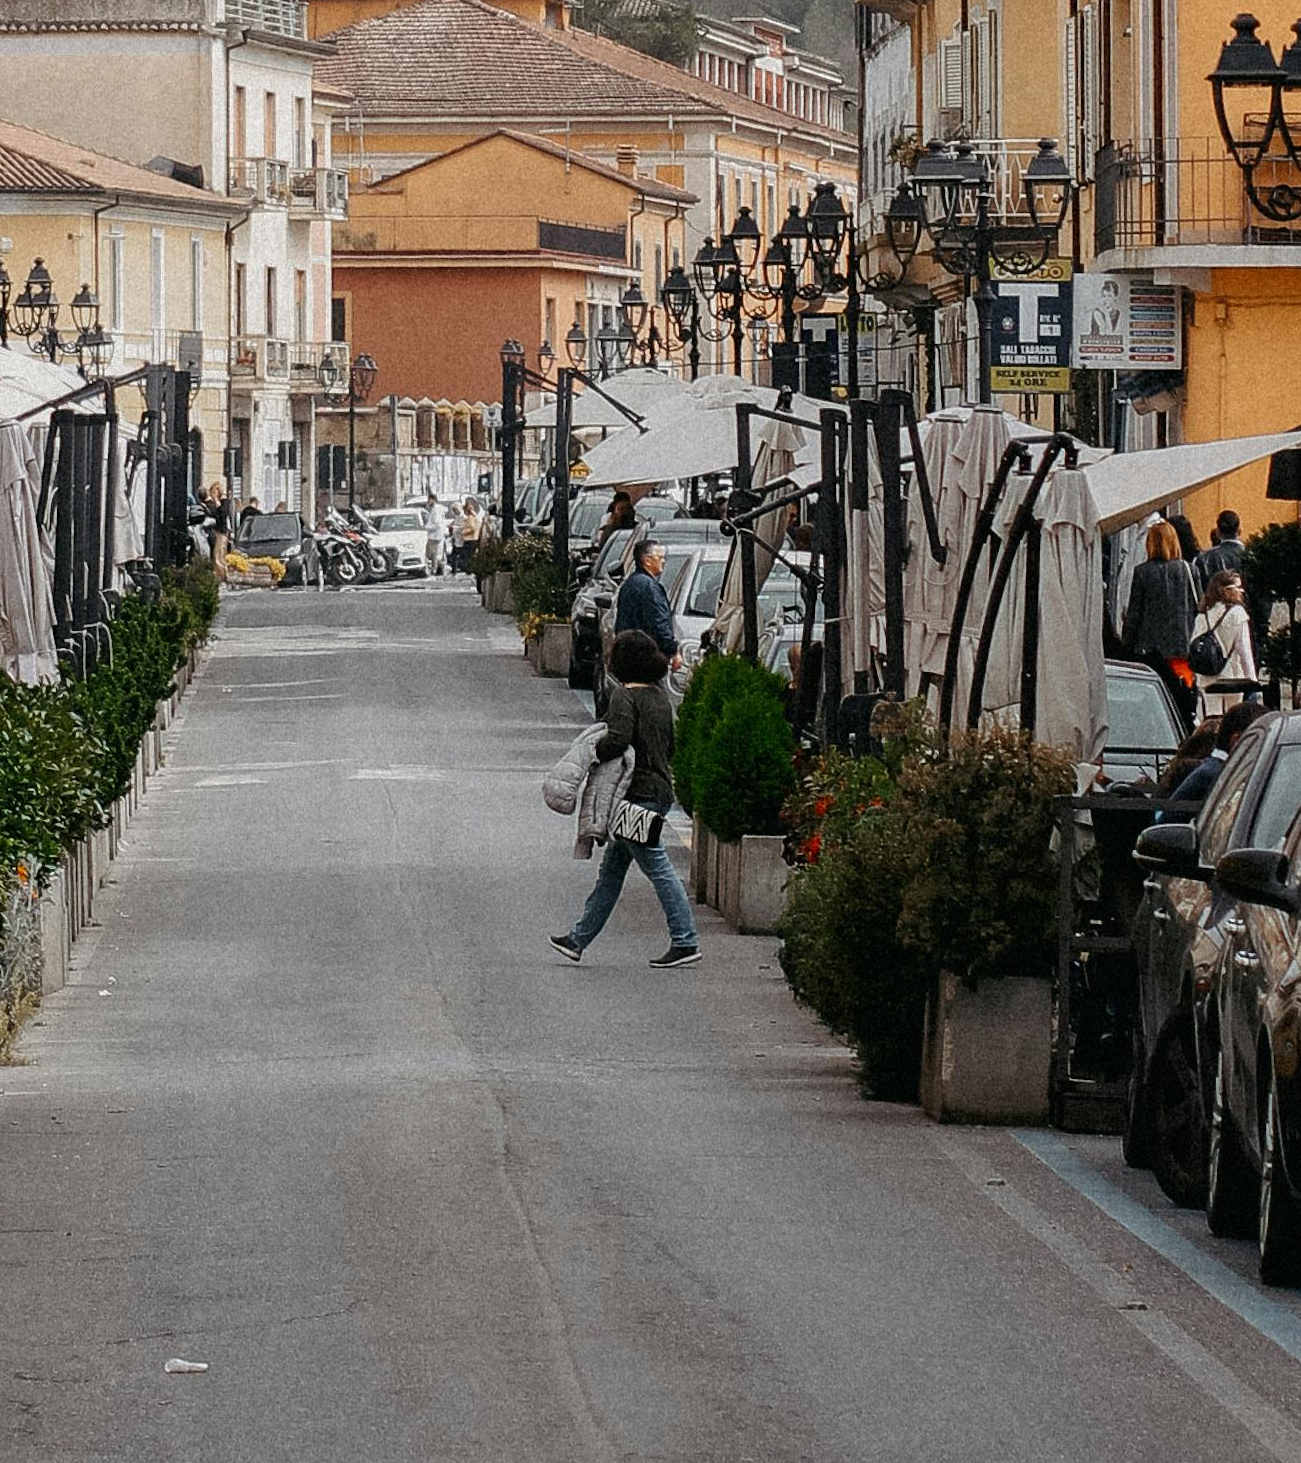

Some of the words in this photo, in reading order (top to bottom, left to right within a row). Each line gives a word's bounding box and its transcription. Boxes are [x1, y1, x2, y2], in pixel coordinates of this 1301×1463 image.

[998, 282, 1060, 344] T
[840, 315, 875, 332] LTO
[1020, 345, 1057, 355] TABACCHI
[1000, 355, 1027, 364] VALORI
[1027, 355, 1058, 364] BOLLATI
[996, 370, 1017, 378] SELF
[1020, 370, 1061, 378] SERVICE
[1023, 378, 1047, 387] ORE
